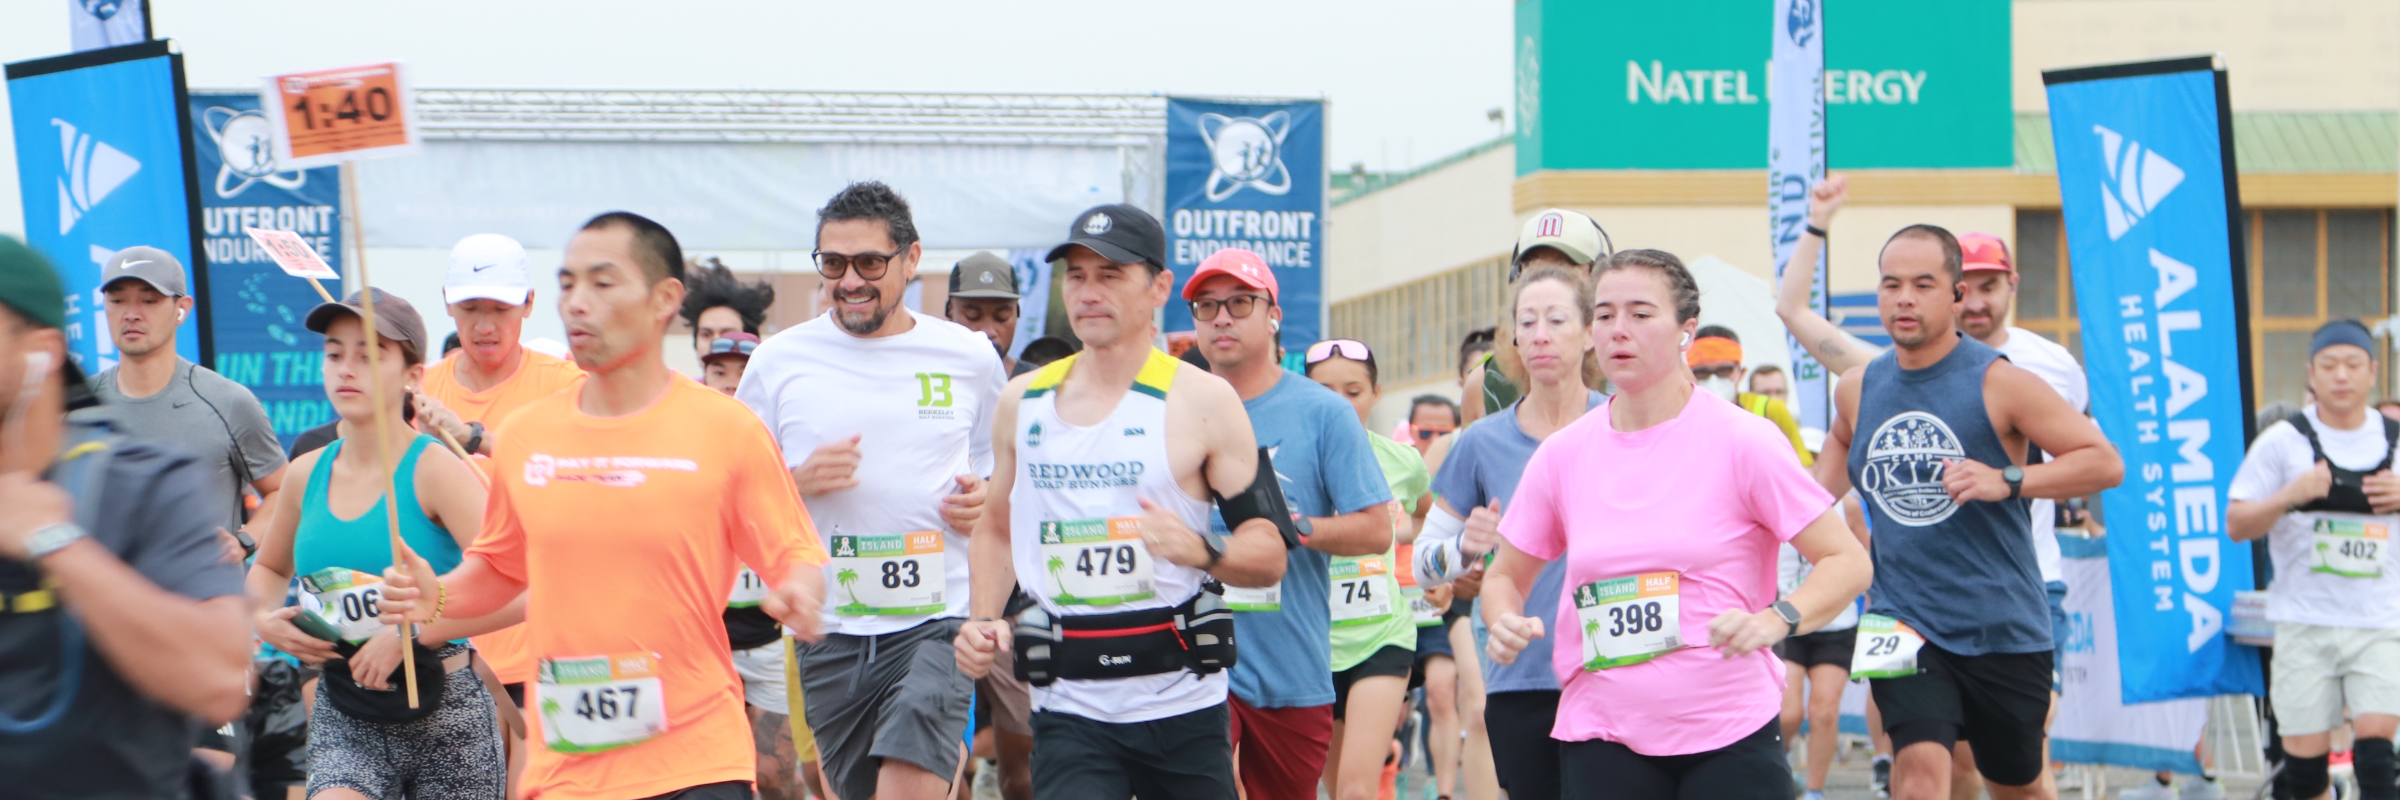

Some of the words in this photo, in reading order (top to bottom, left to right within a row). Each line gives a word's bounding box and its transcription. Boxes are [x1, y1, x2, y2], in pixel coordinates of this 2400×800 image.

[1766, 60, 1927, 104] ERGY
[293, 87, 394, 130] 1:40
[204, 205, 334, 235] UTFRONT
[1174, 209, 1315, 240] OUTFRONT
[266, 238, 311, 259] 1:50
[1891, 454, 1932, 462] CAMP
[2119, 294, 2160, 444] HEALTH
[2142, 462, 2174, 611] SYSTEM
[2149, 247, 2223, 654] ALAMEDA
[1027, 461, 1144, 479] REDWOOD
[1861, 461, 1945, 493] OKIZ
[1068, 476, 1138, 489] RUNNERS
[913, 535, 936, 544] HALF
[1063, 524, 1105, 536] ISLAND
[861, 541, 901, 550] ISLAND
[2340, 540, 2377, 560] 402
[1076, 544, 1136, 577] 479
[1329, 565, 1358, 575] SLAND
[881, 560, 920, 588] 83
[1646, 577, 1671, 586] HALF
[1342, 580, 1371, 604] 74
[1600, 583, 1635, 597] ISLAND
[1609, 602, 1663, 637] 398
[1867, 635, 1901, 656] 29
[575, 686, 640, 721] 467
